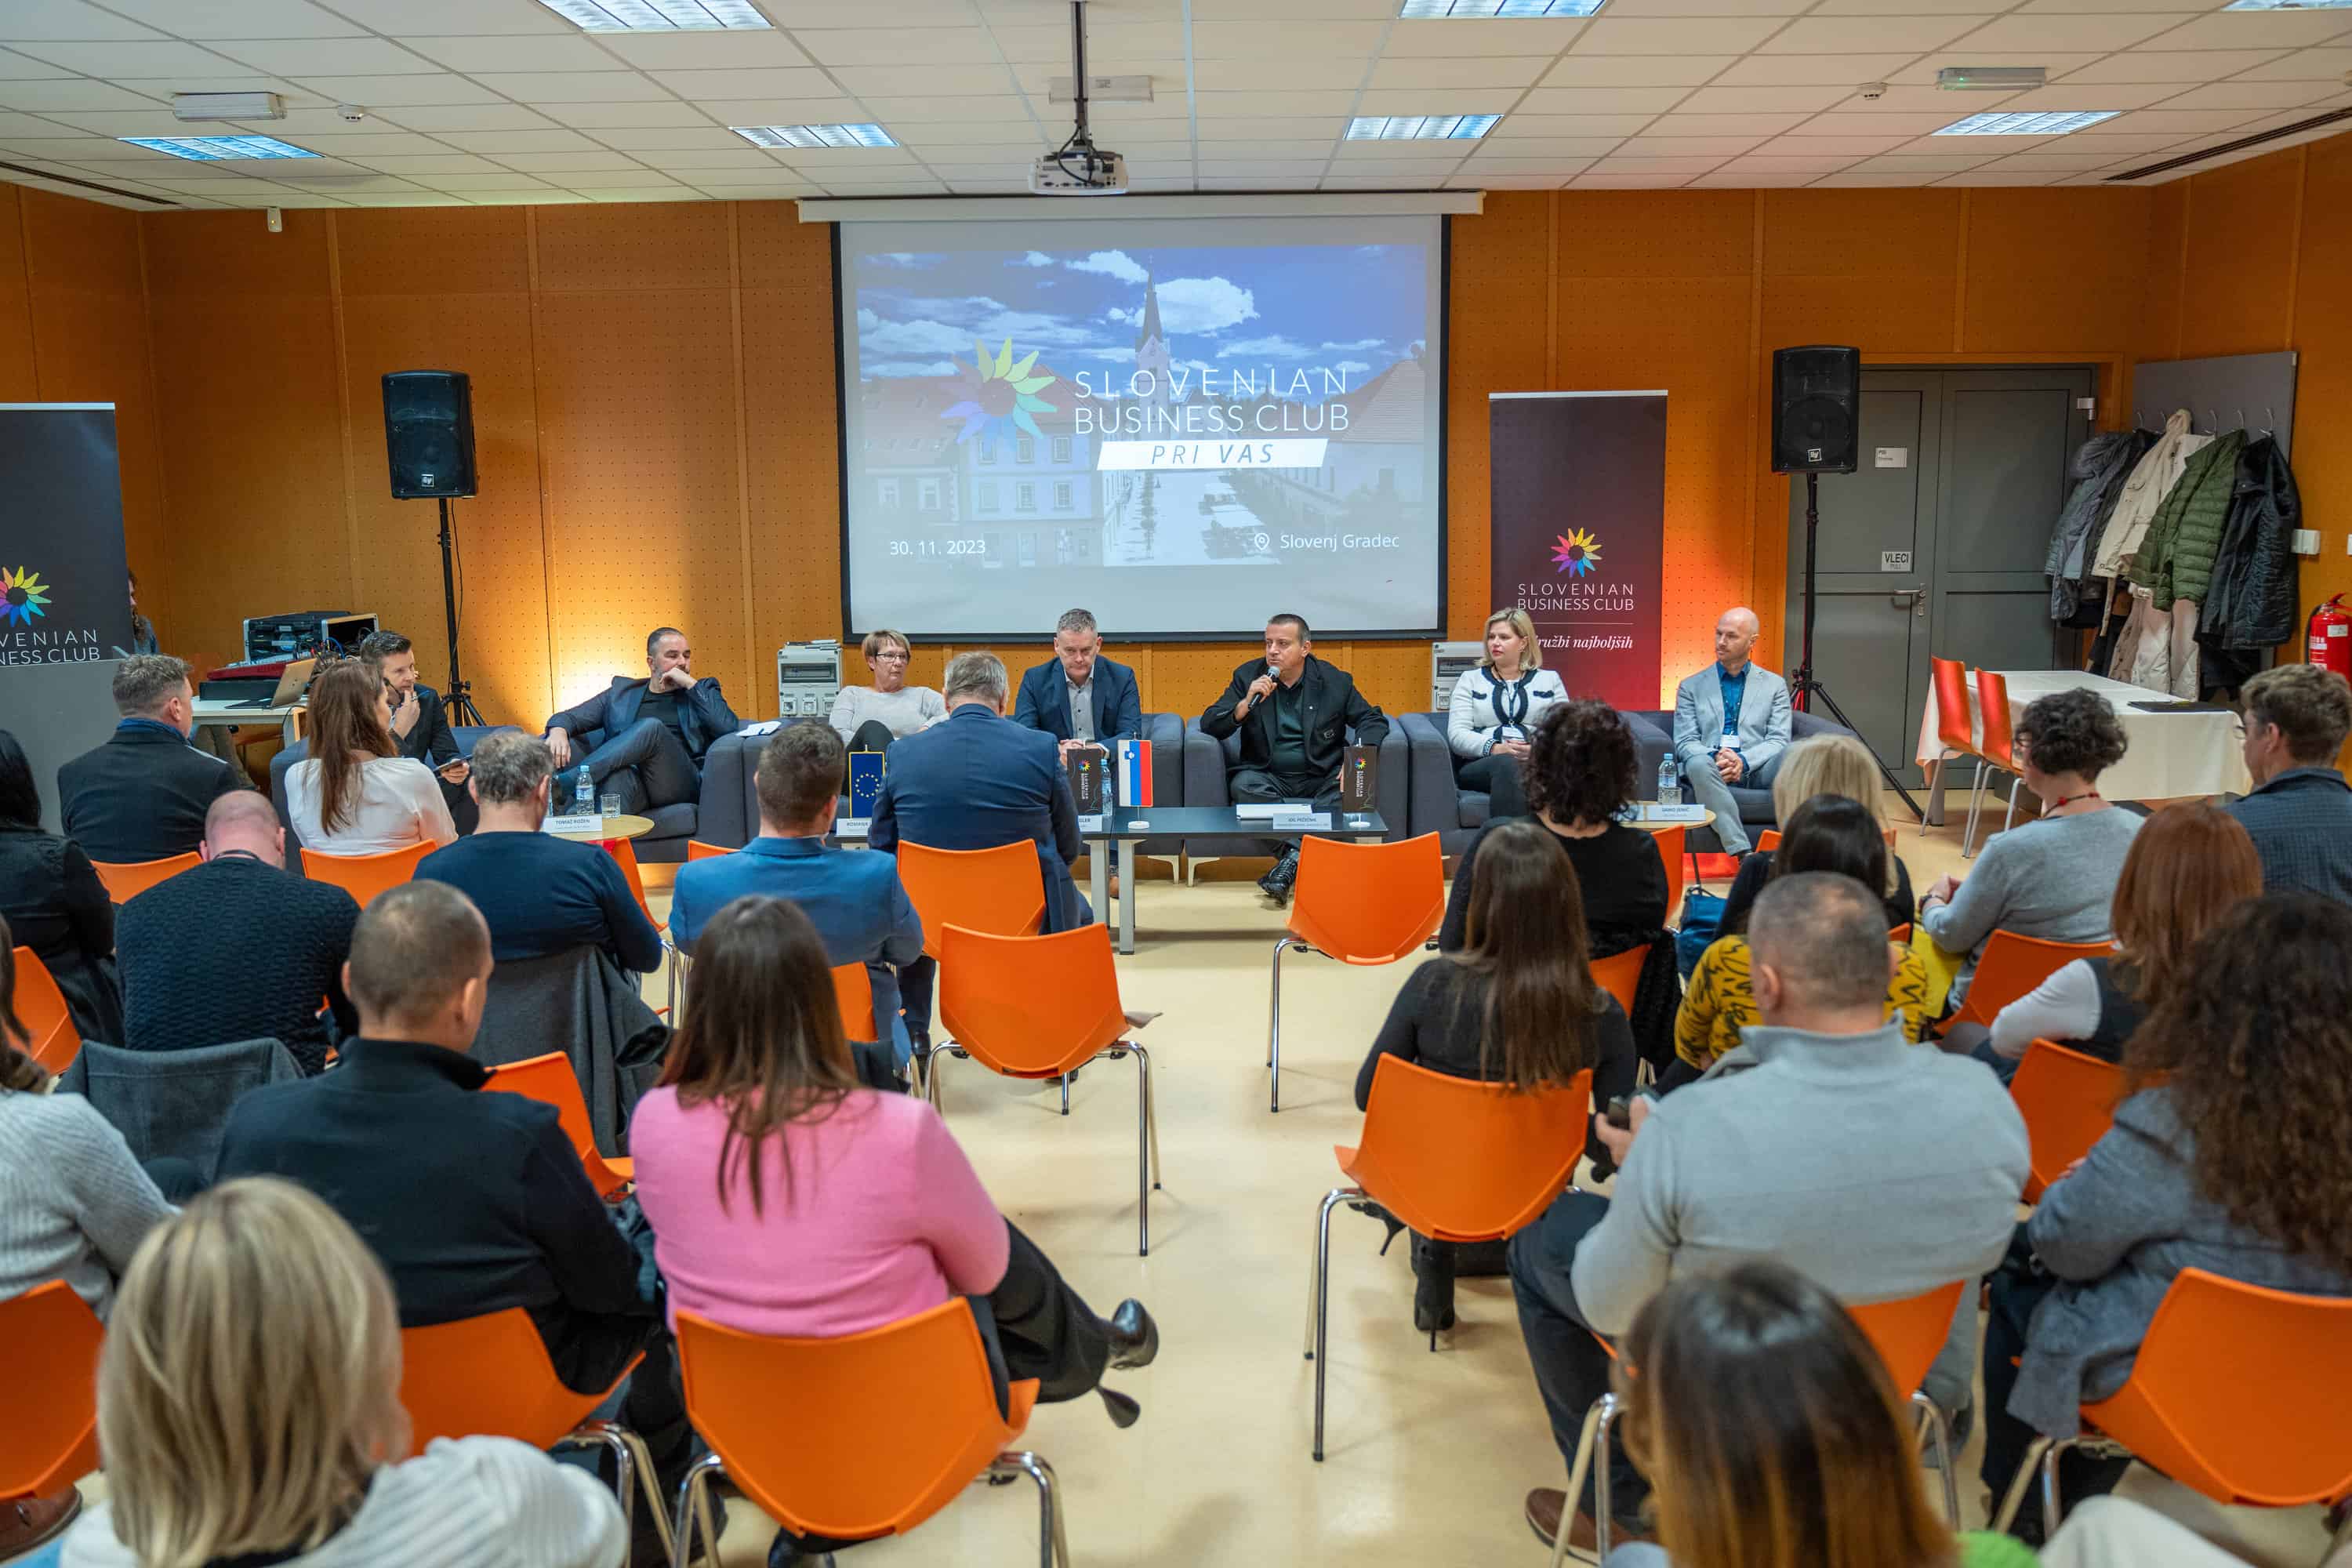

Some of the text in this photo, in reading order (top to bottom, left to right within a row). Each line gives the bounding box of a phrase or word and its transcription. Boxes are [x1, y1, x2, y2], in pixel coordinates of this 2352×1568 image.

[1075, 368, 1346, 398] SLOVENIAN
[1075, 404, 1349, 434] BUSINESS CLUB
[1152, 444, 1274, 464] PRI VAS
[890, 539, 985, 555] 30. 11. 2023
[1280, 534, 1399, 553] Slovenj Gradec
[1885, 553, 1908, 563] VLECI
[1518, 583, 1633, 596] SLOVENIAN
[1518, 598, 1634, 611] BUSINESS CLUB
[1536, 635, 1633, 651] ružbi najboljših
[48, 647, 100, 663] CLUB
